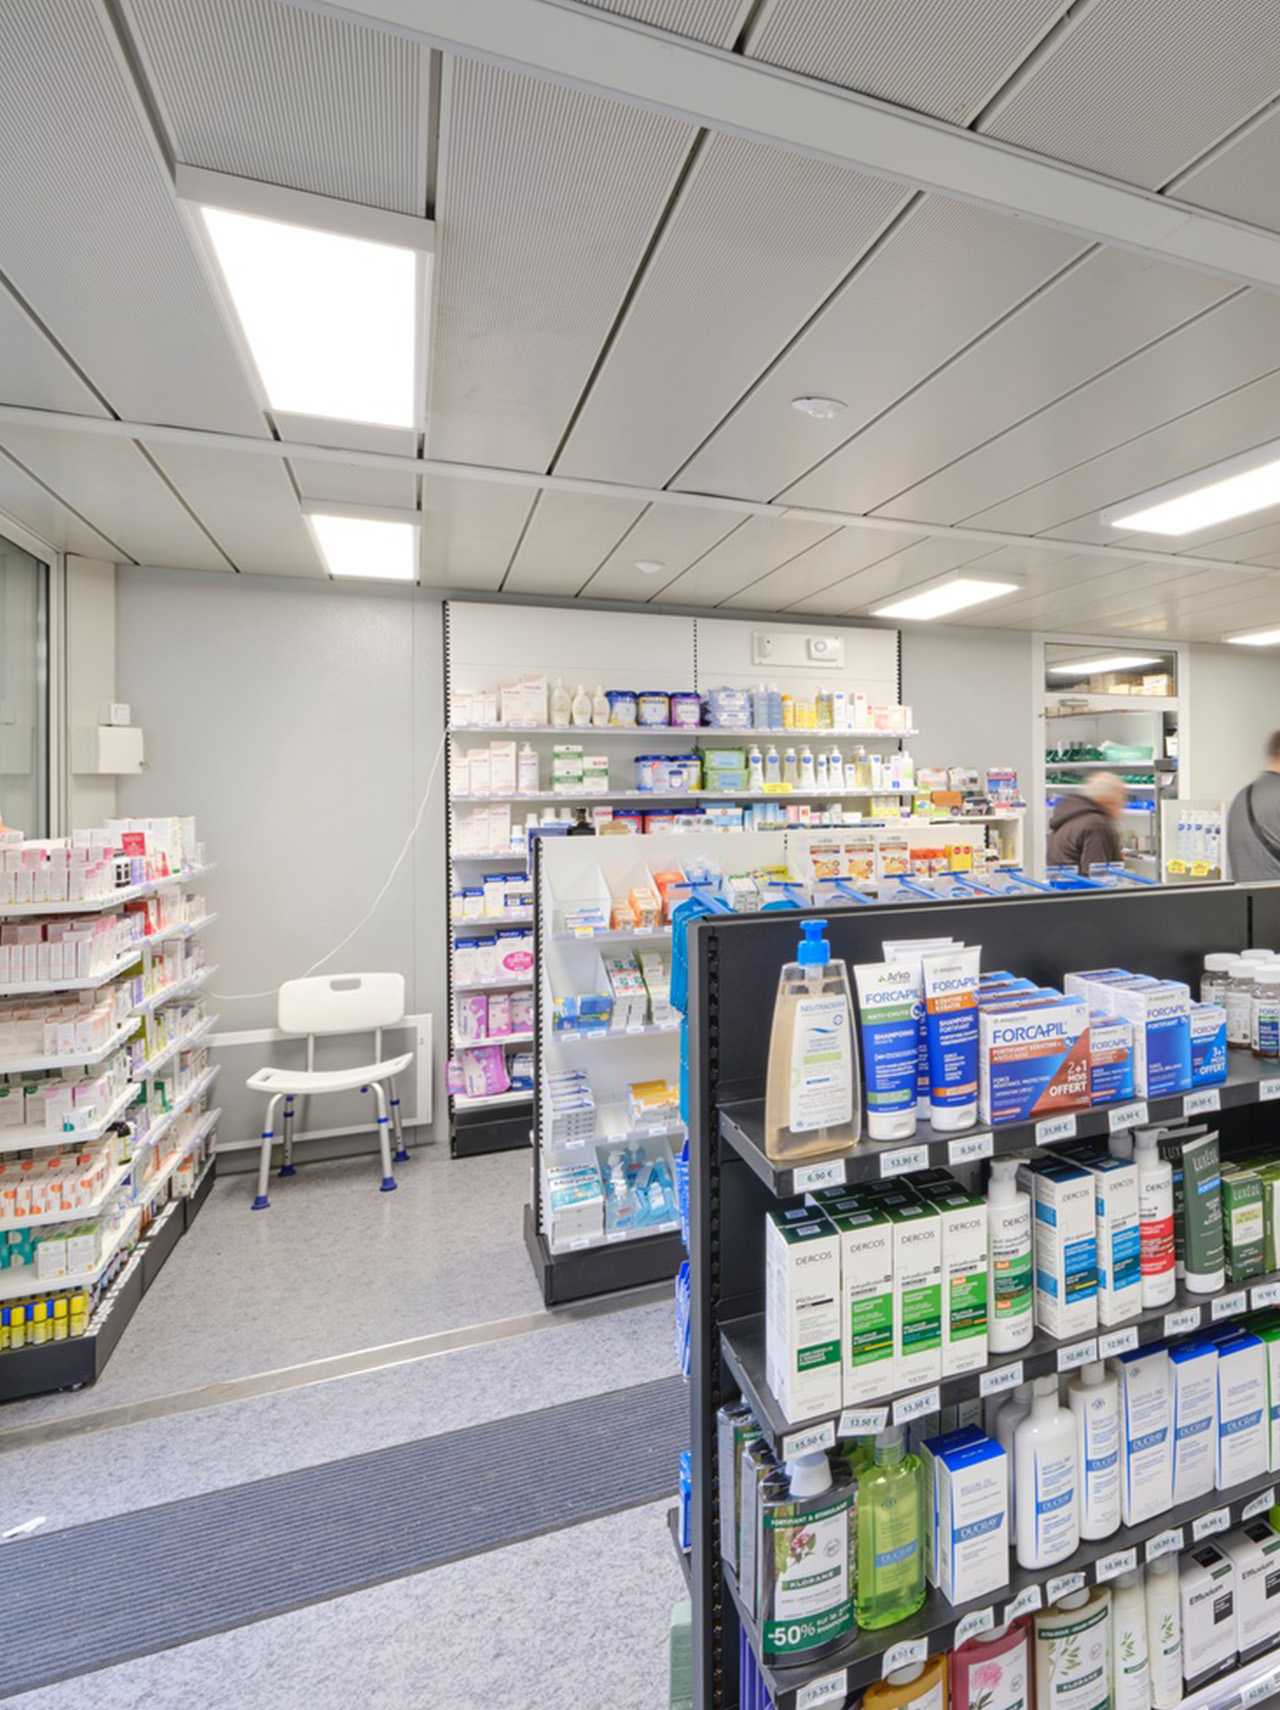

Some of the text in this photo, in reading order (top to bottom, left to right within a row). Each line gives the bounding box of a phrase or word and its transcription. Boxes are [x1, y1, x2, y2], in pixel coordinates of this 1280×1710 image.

[993, 1022, 1068, 1044] FORCAPIL
[1068, 1060, 1088, 1074] 2+1
[1199, 1062, 1226, 1076] OFFERT
[1068, 1074, 1087, 1082] MOIS
[1049, 1081, 1087, 1096] OFFERT
[891, 1156, 912, 1166] 13,90
[806, 1172, 826, 1182] 6,90
[1110, 1178, 1134, 1191] DERCOS
[1062, 1188, 1090, 1202] DERCOS
[949, 1220, 982, 1233] DERCOS
[901, 1230, 936, 1244] DERCOS
[850, 1238, 886, 1254] DERCOS
[795, 1250, 833, 1266] DERCOS
[1180, 1420, 1208, 1437] DUCRAY
[1227, 1412, 1259, 1432] DUCRAY
[1132, 1431, 1164, 1450] DUCRAY
[1042, 1493, 1070, 1512] DUCRAY
[961, 1517, 998, 1539] DUCRAY
[789, 1571, 836, 1588] KLORANE
[768, 1622, 816, 1646] -50%
